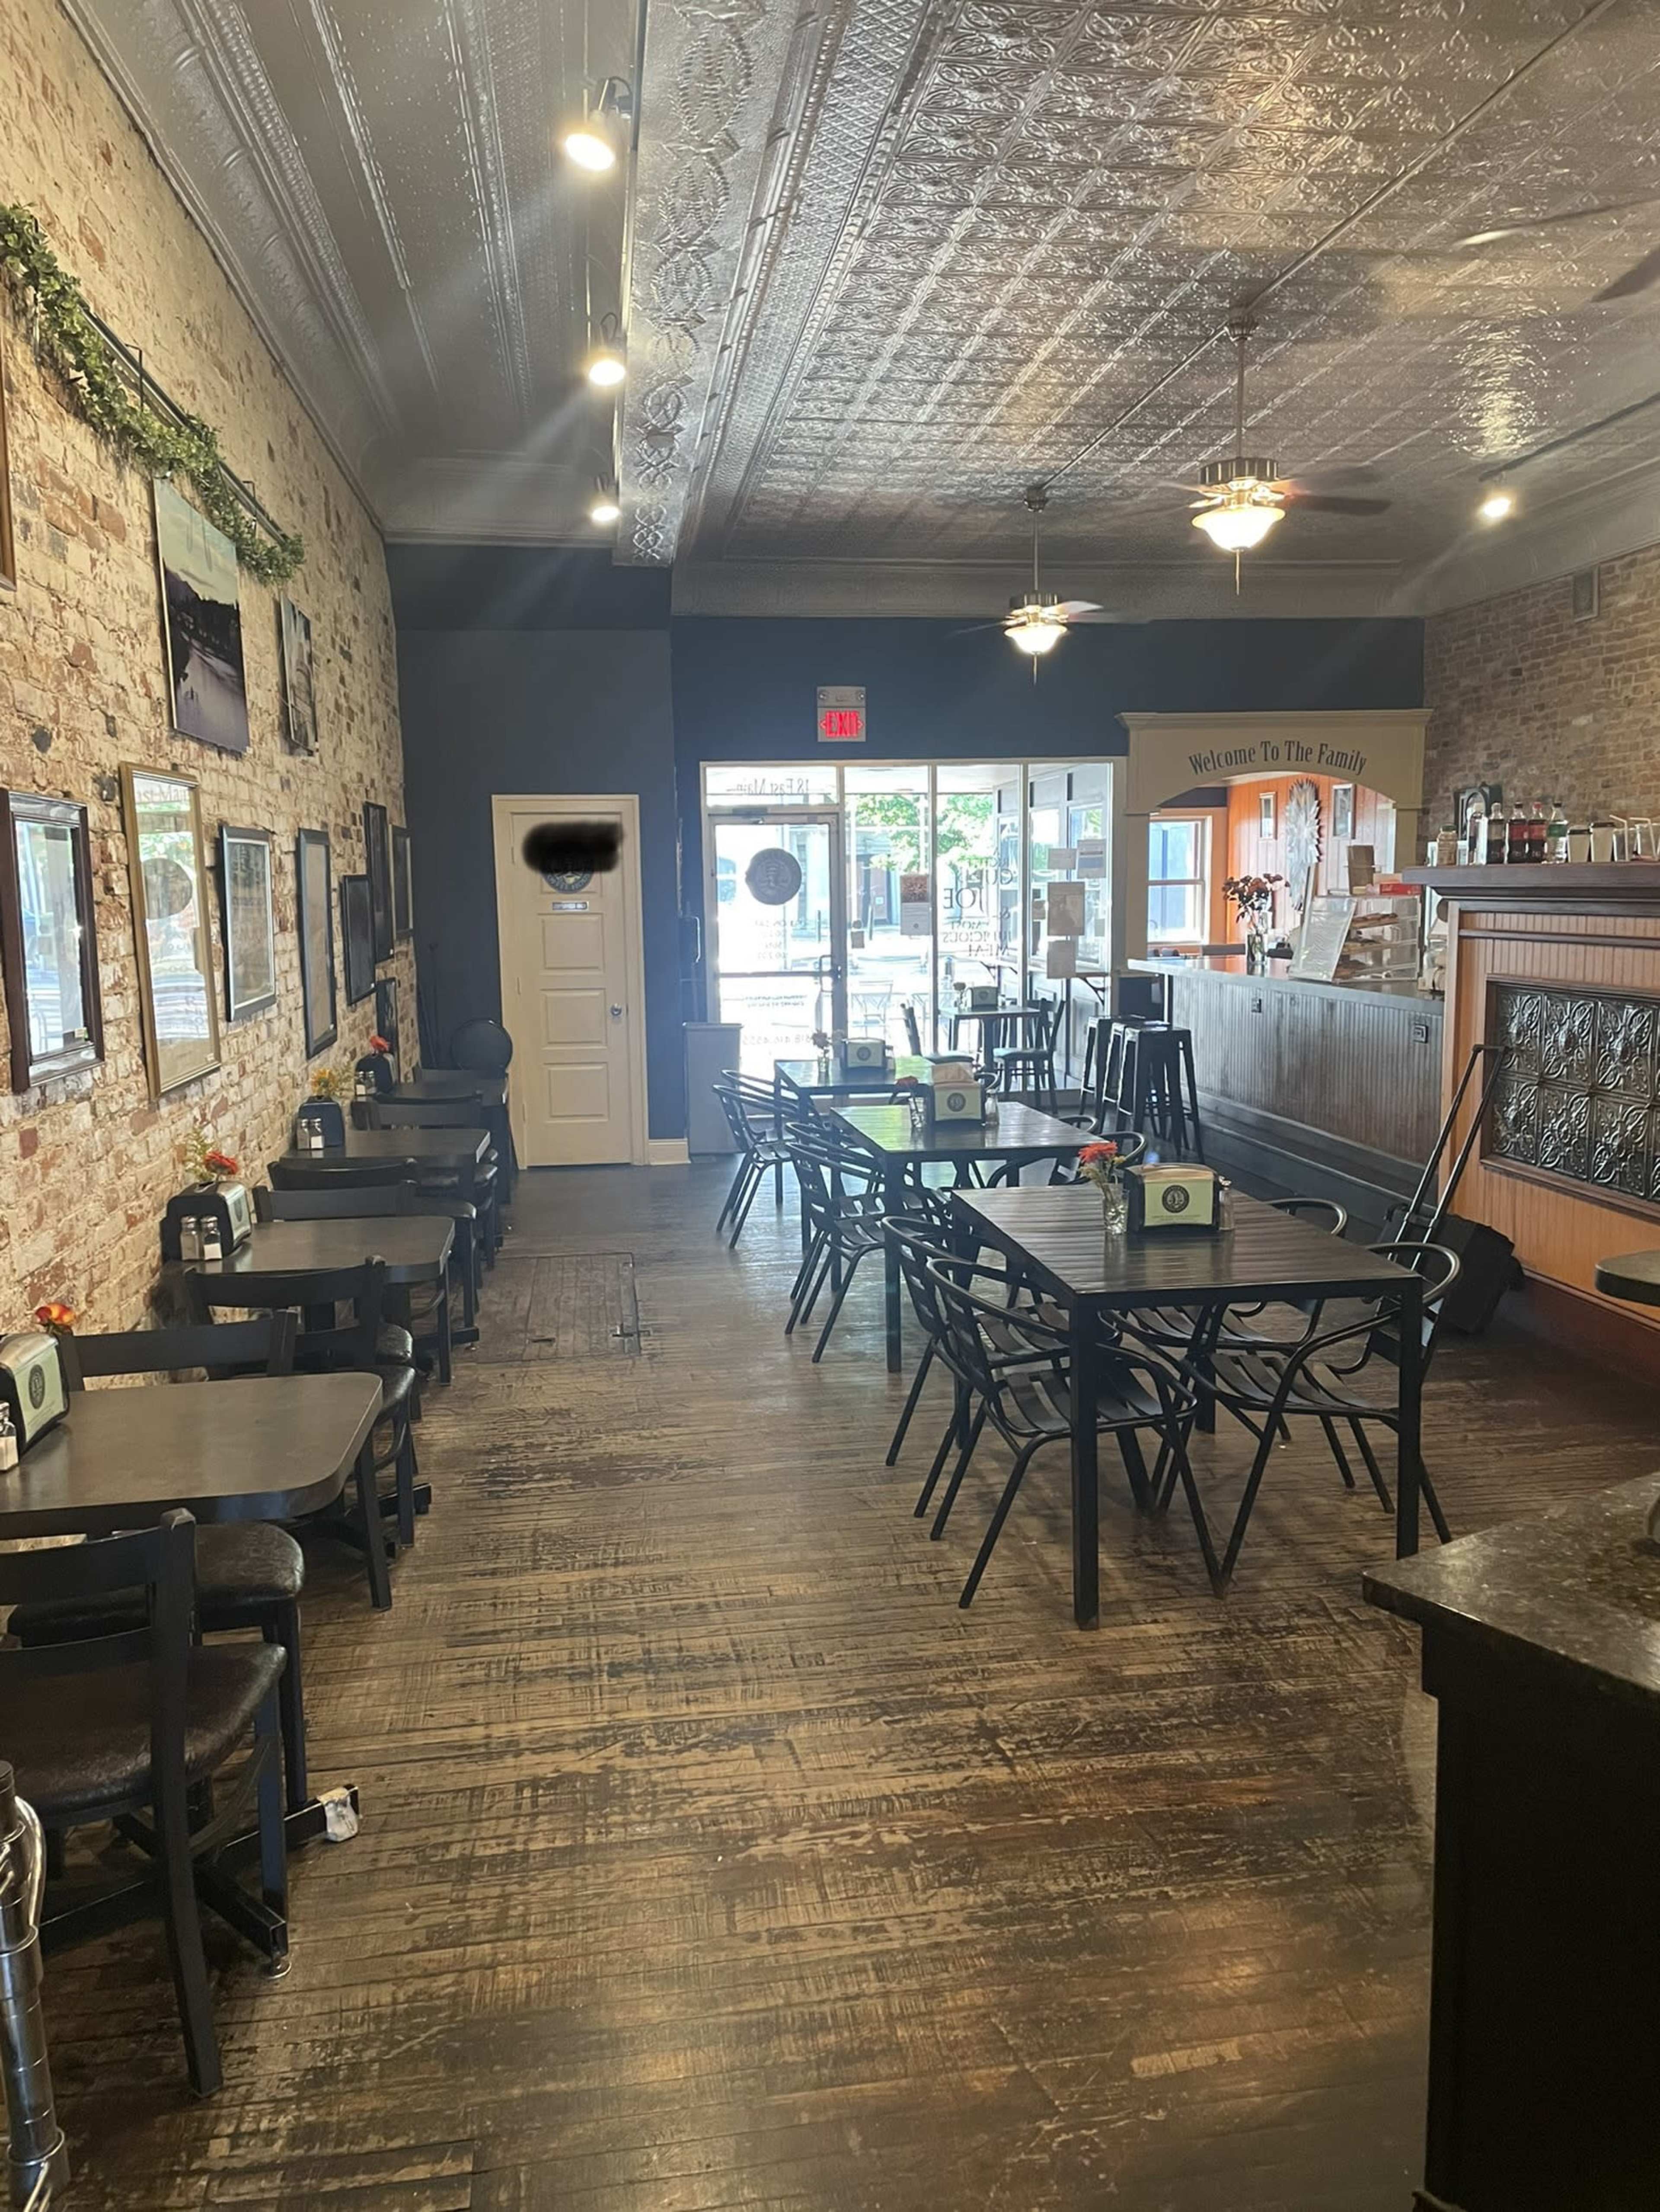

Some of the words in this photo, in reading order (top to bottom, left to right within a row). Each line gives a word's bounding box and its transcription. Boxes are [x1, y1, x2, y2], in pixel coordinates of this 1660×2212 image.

[826, 711, 858, 737] EXIT
[1189, 747, 1256, 775] Welcome
[1261, 741, 1279, 761] To
[1284, 740, 1312, 762] The
[1317, 743, 1367, 776] Family
